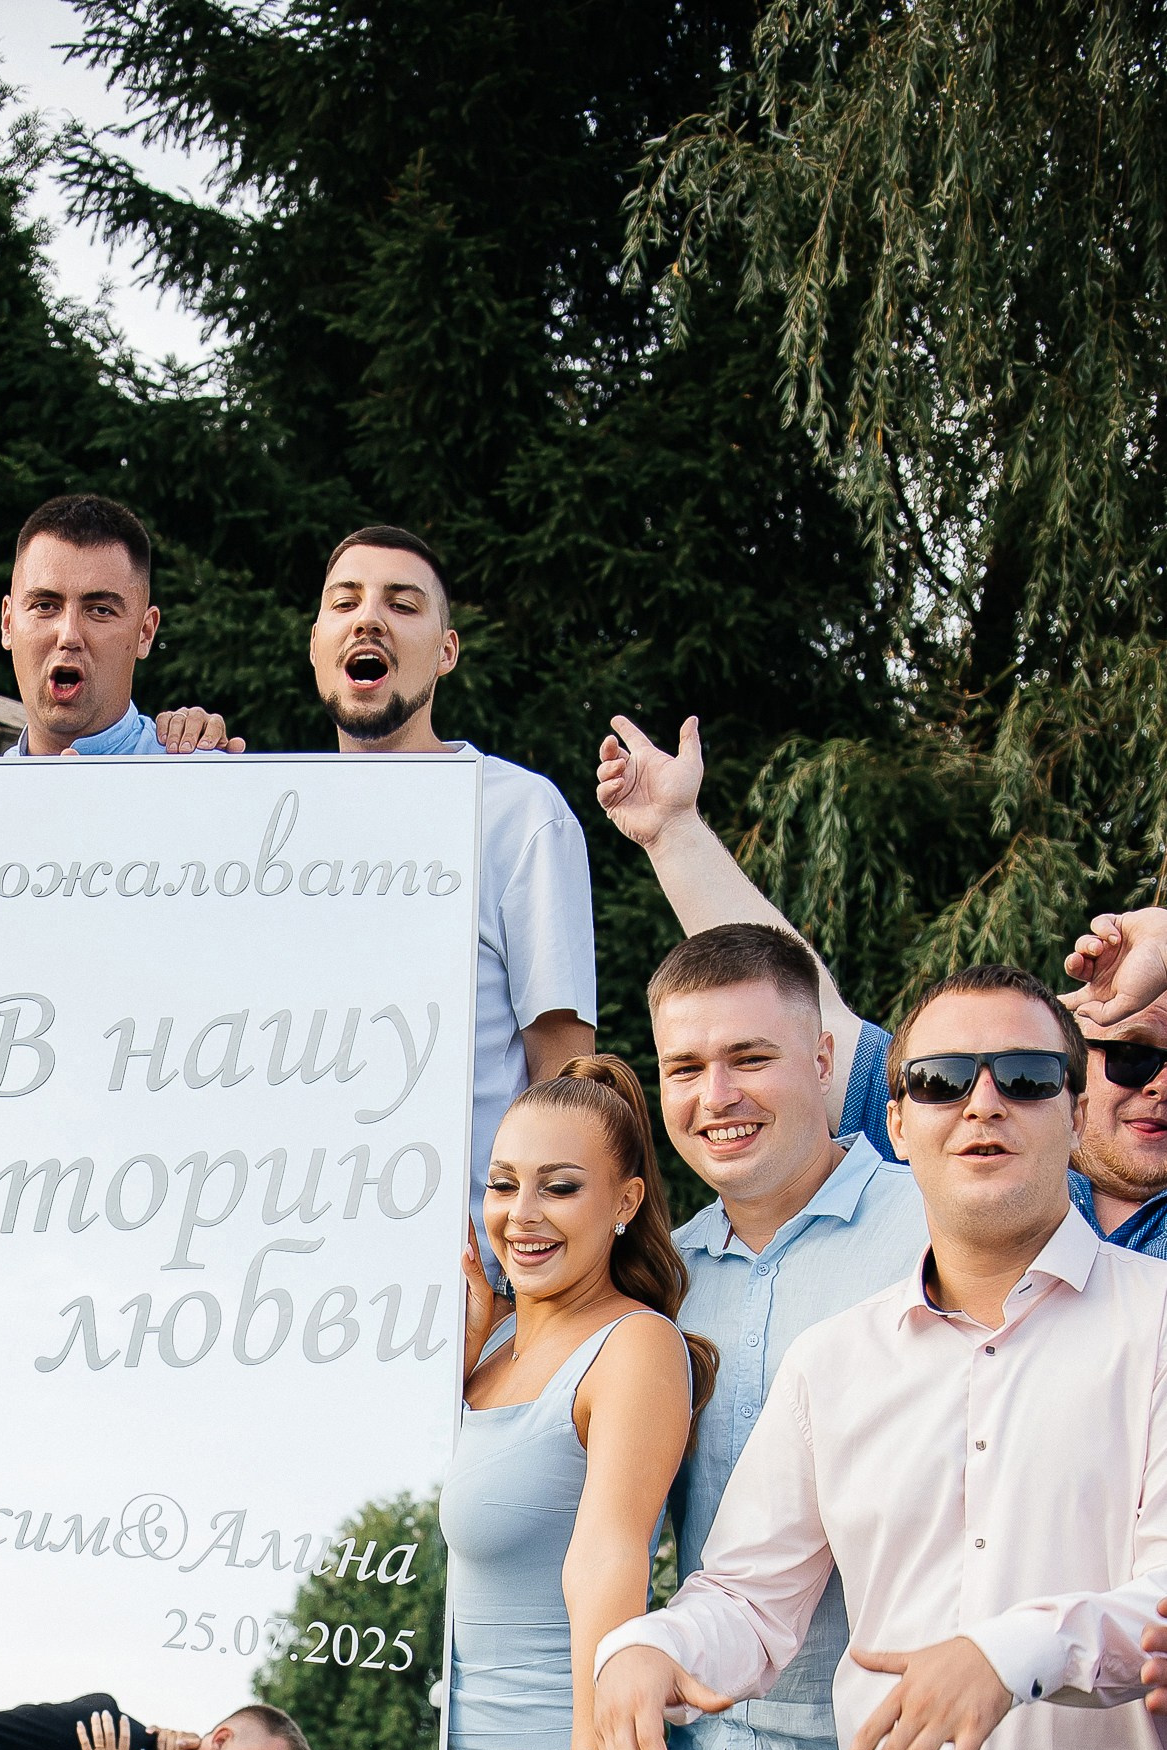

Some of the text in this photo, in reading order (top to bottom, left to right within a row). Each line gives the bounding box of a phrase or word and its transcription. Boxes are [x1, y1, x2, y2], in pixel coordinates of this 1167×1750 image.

[103, 1002, 440, 1123] нашу
[34, 1238, 446, 1372] любви
[162, 1608, 416, 1672] 25.07.2025
